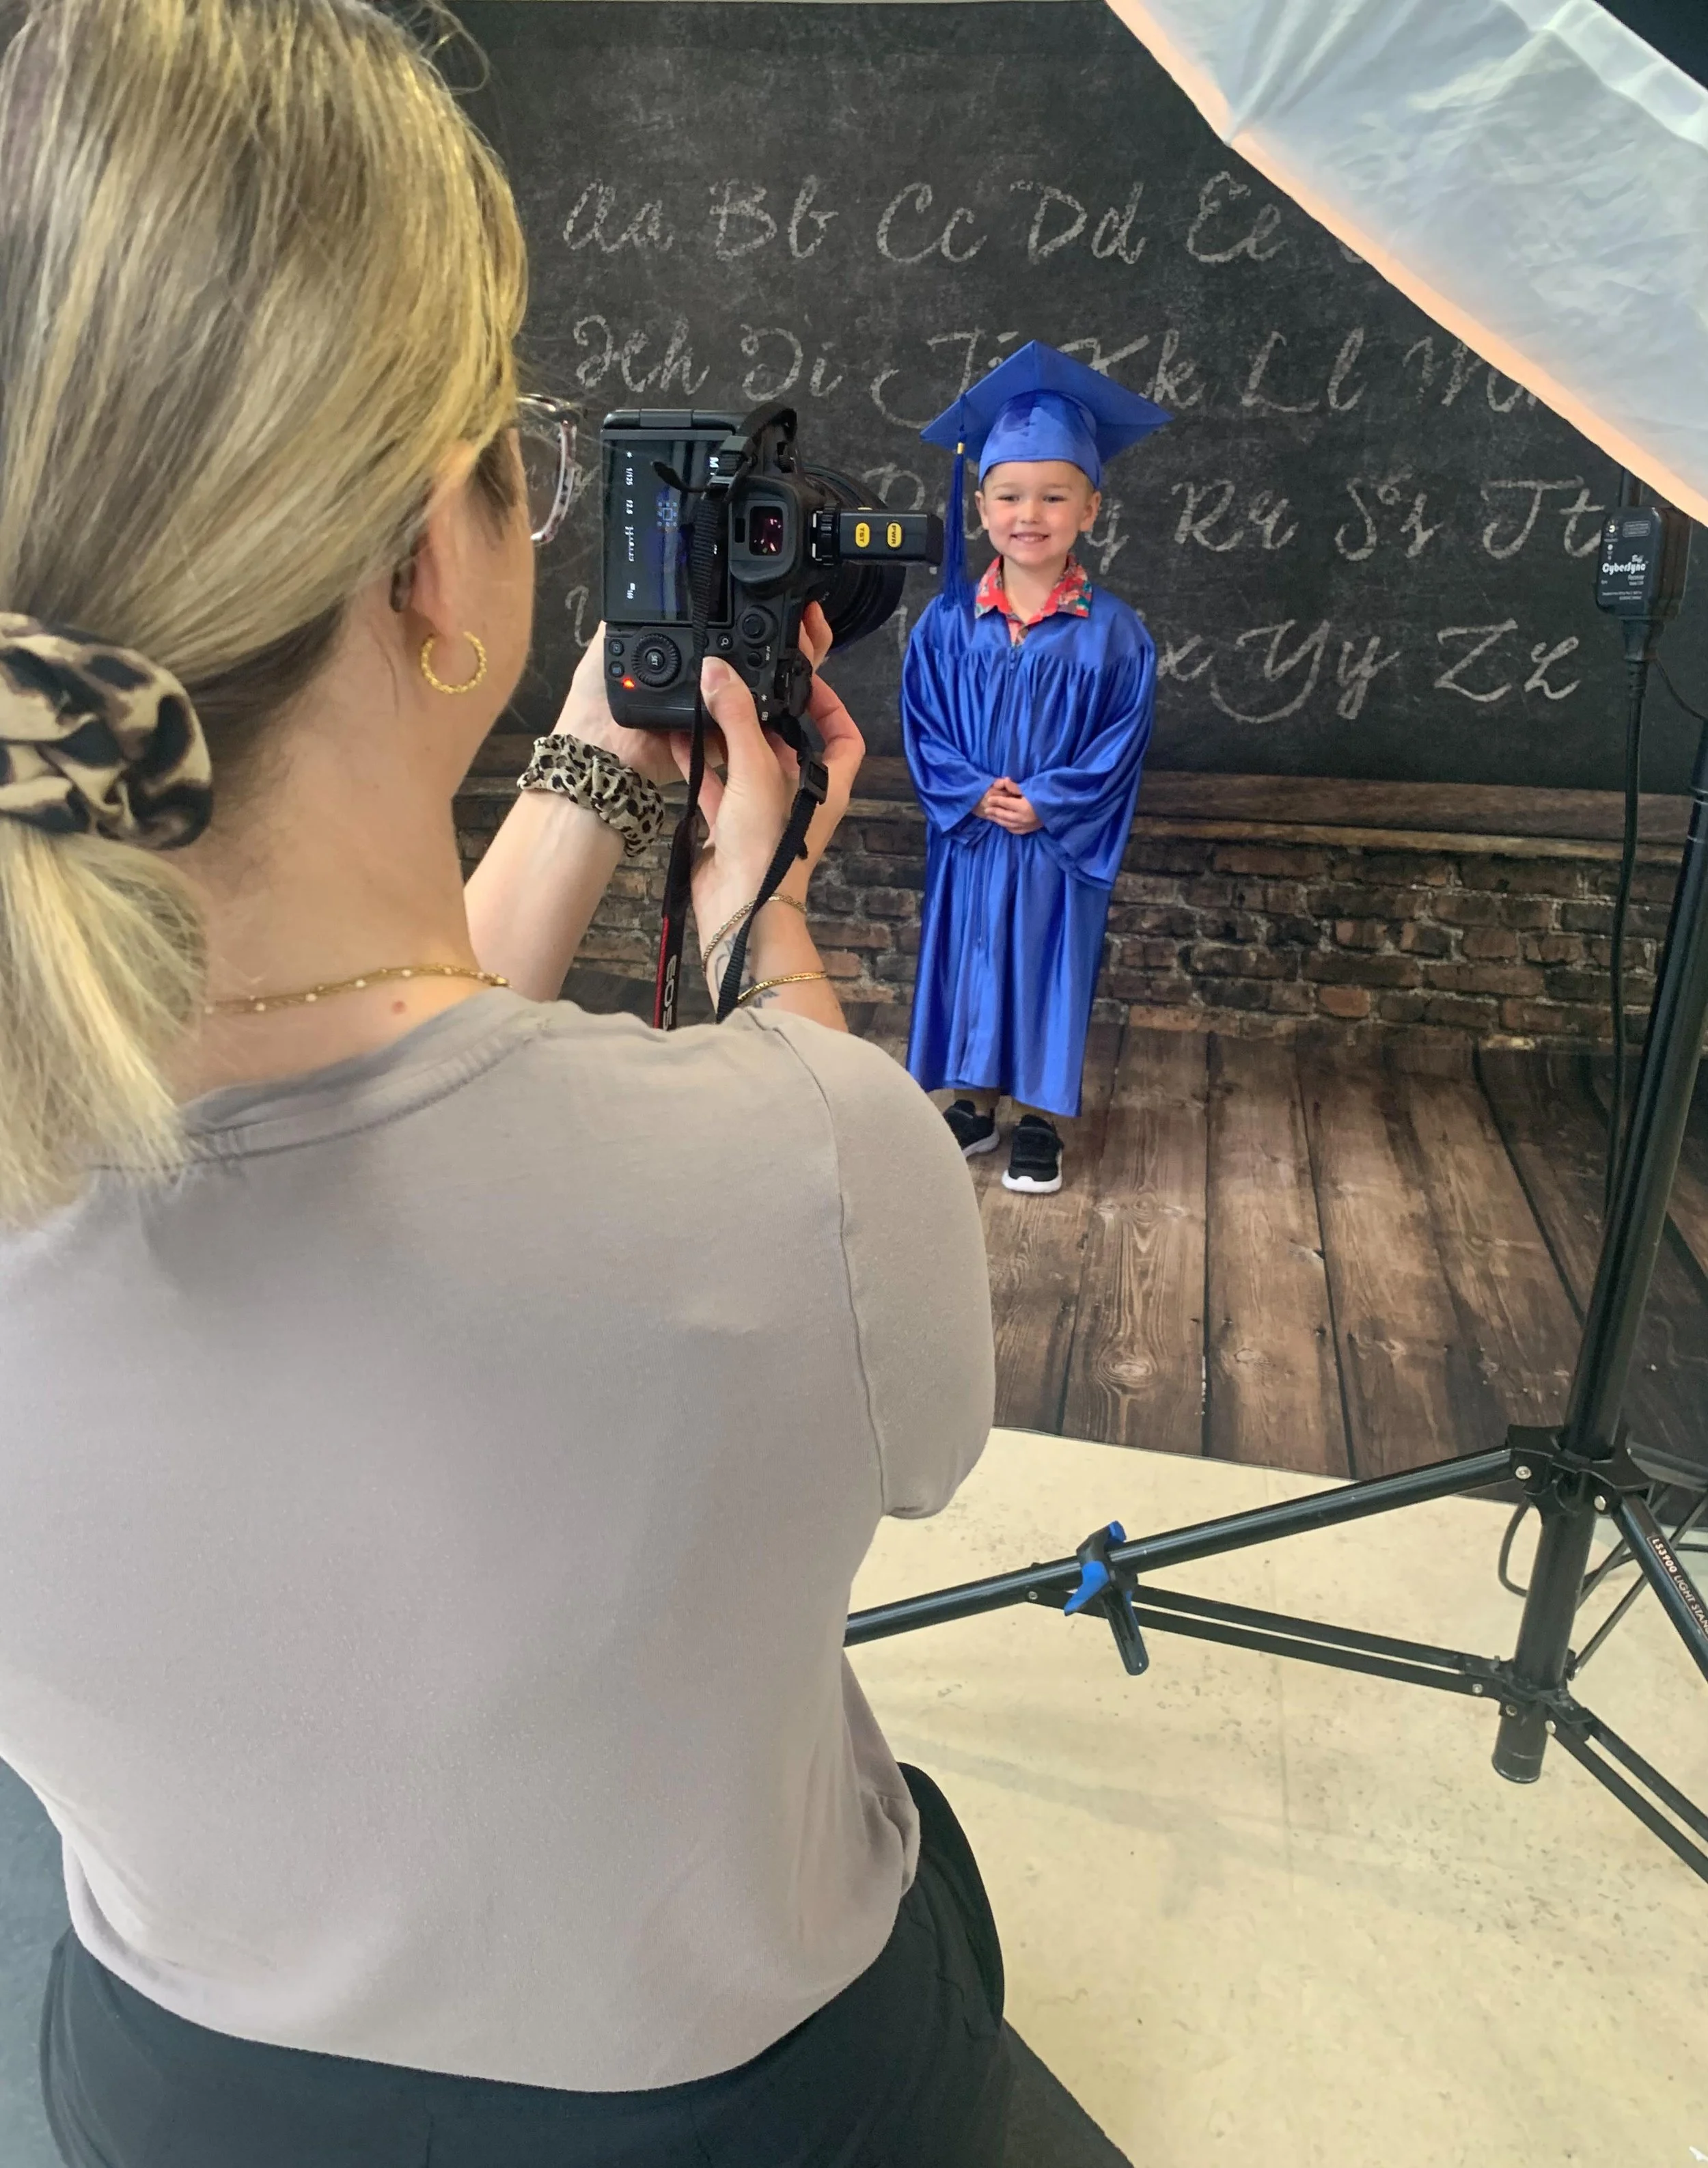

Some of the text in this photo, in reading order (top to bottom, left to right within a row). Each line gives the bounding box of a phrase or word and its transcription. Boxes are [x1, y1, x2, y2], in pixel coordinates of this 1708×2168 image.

[709, 175, 838, 262] Bb
[877, 182, 987, 262] Cc
[1010, 180, 1148, 264] Dd
[1241, 329, 1366, 411] Ll
[1171, 480, 1299, 551] Rr
[1210, 619, 1401, 724] Yy
[1435, 618, 1581, 702] Zz
[1652, 1538, 1678, 1573] LS3900
[1675, 1574, 1696, 1602] LIGHT
